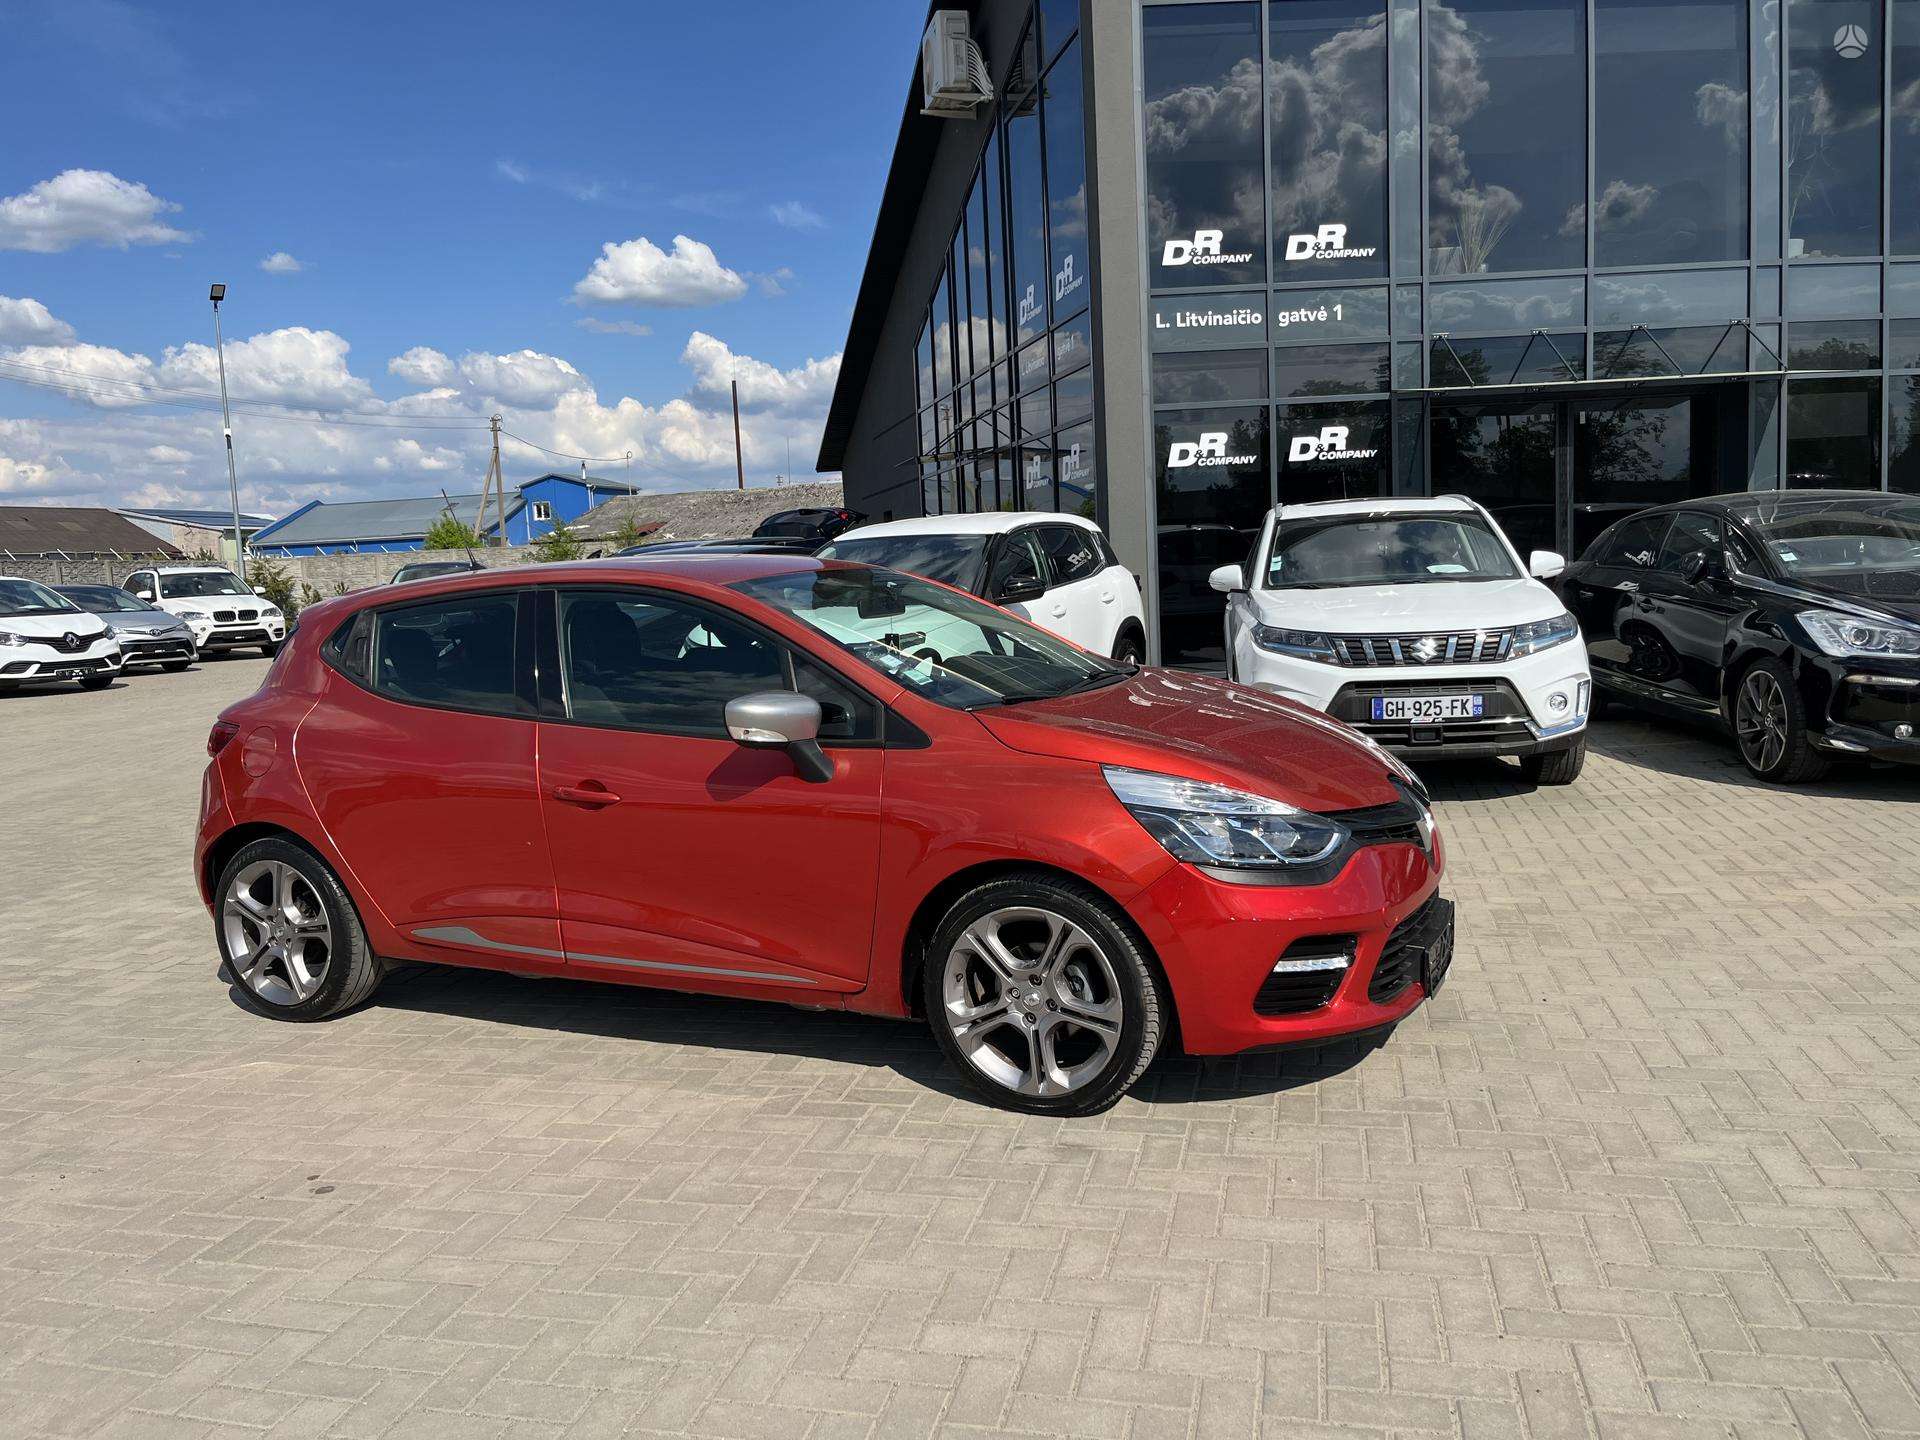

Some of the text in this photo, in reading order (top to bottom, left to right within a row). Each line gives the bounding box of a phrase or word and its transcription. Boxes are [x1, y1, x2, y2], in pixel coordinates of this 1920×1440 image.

[1192, 253, 1253, 265] COMPANY
[1316, 247, 1376, 259] COMPANY
[1056, 254, 1073, 302] DR
[1155, 303, 1343, 328] L. Litvinaičio gatvė 1
[1318, 449, 1378, 460] COMPANY
[1197, 455, 1257, 467] COMPANY
[1385, 698, 1470, 718] GH-925-FK
[1473, 706, 1483, 715] 59
